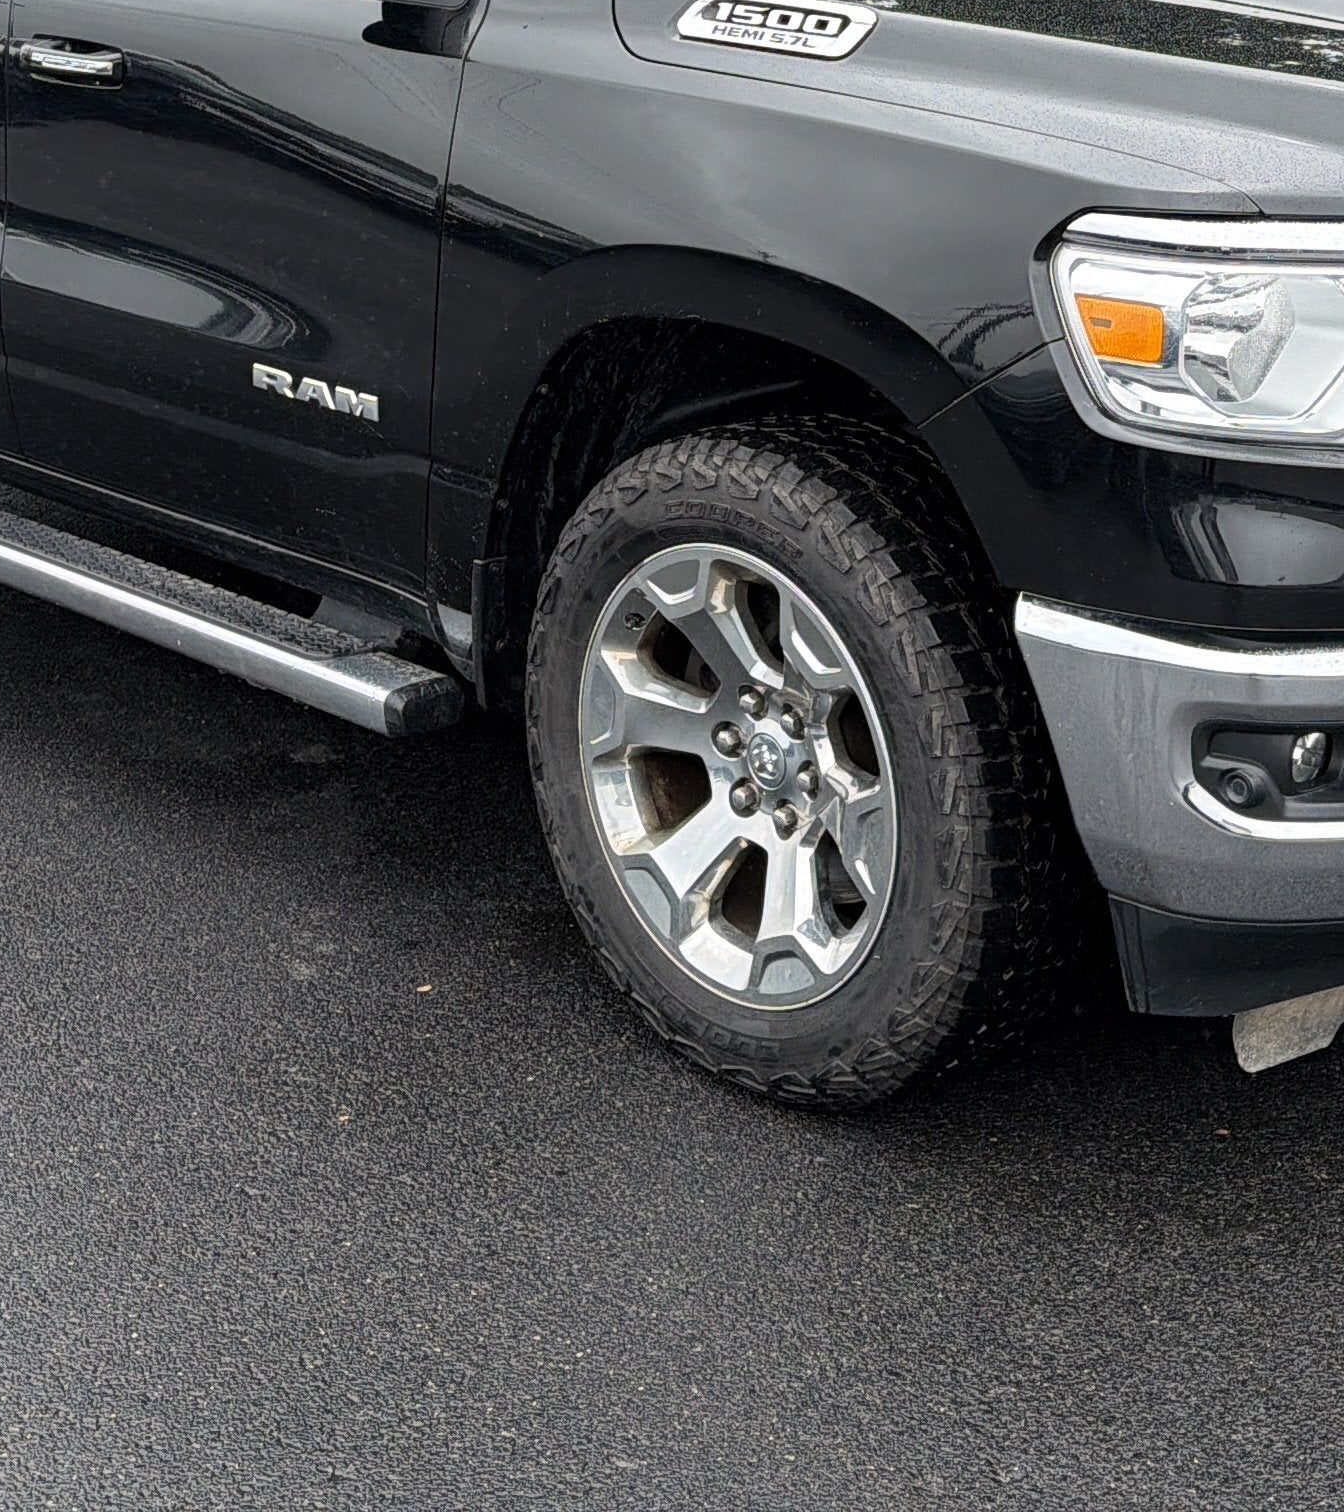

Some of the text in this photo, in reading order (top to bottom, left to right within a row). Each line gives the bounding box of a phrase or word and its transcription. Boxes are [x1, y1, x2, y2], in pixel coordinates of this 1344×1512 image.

[711, 25, 817, 48] HEMI 5.7L
[714, 1, 843, 37] 1500
[252, 362, 380, 423] RAM
[664, 499, 804, 560] COOPER
